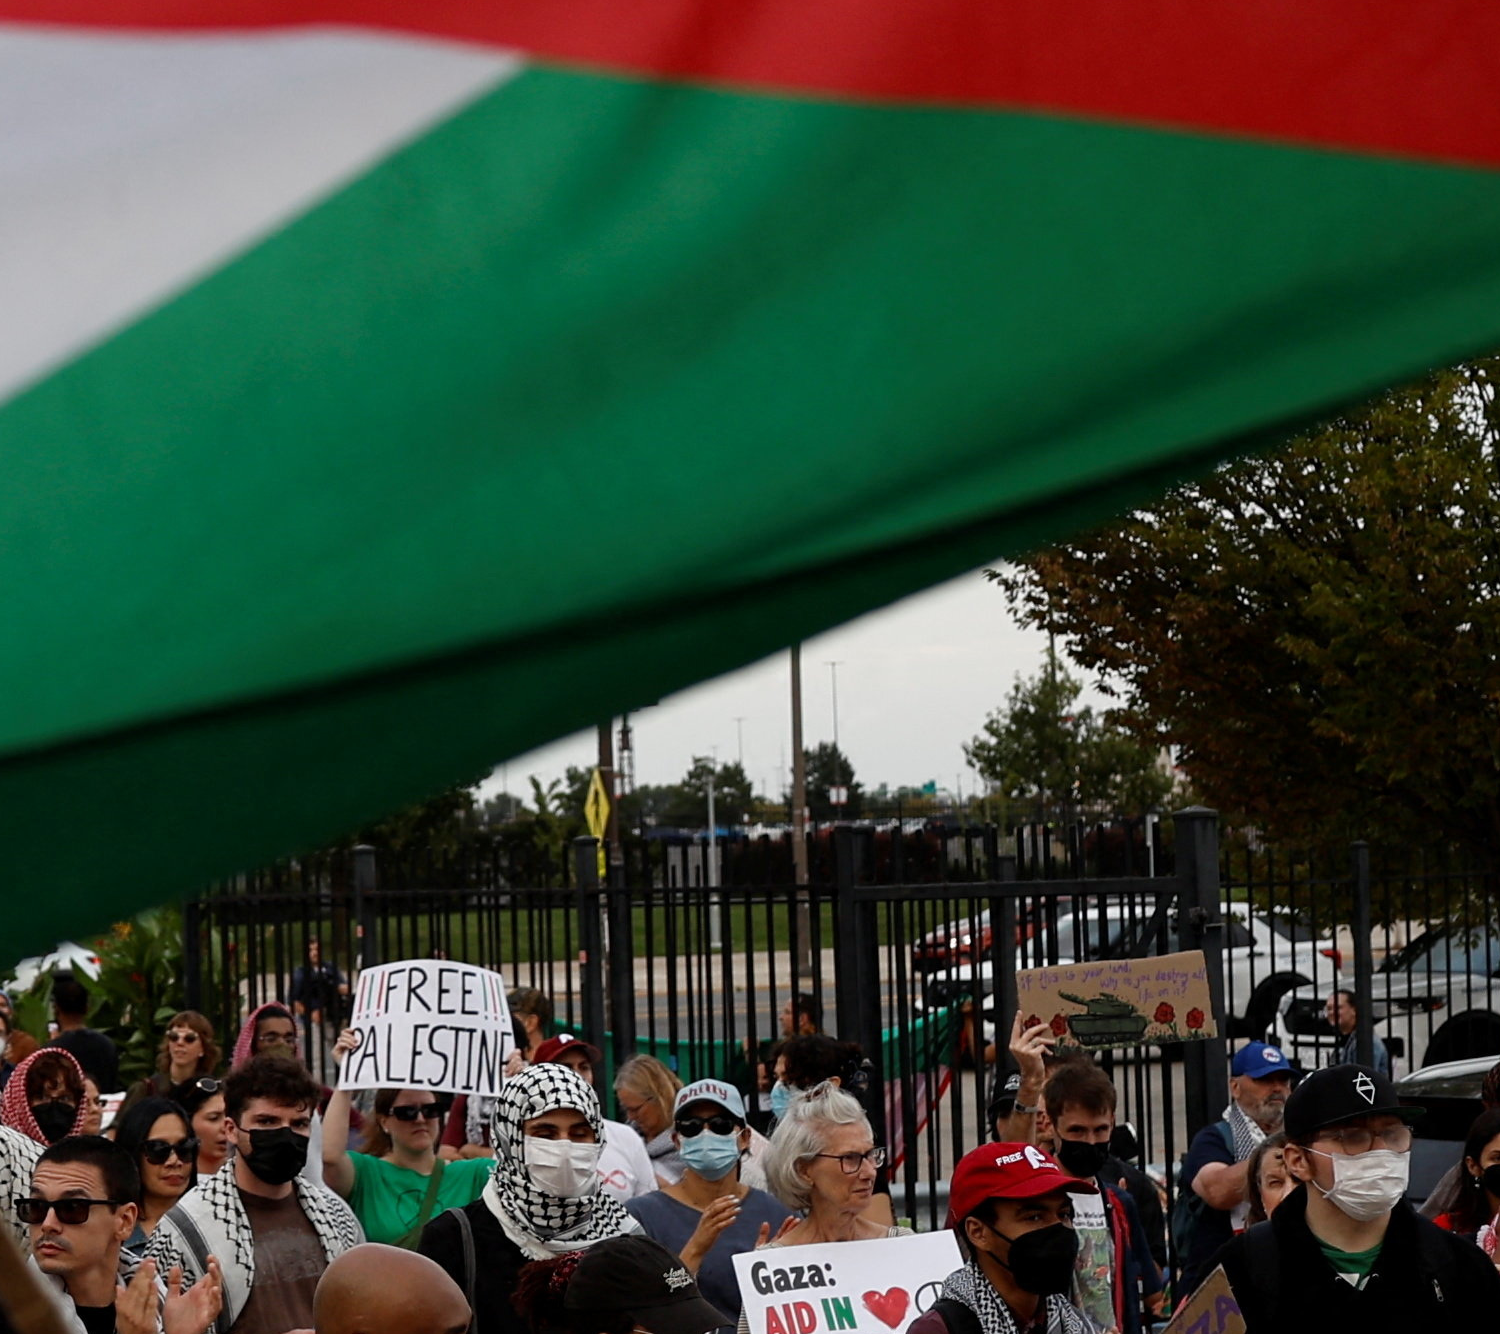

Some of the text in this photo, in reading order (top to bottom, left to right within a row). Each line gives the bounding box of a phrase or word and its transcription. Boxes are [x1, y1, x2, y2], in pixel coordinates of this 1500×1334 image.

[345, 1023, 512, 1094] PALESTINE
[751, 1261, 837, 1296] Gaza:
[821, 1296, 858, 1331] IN
